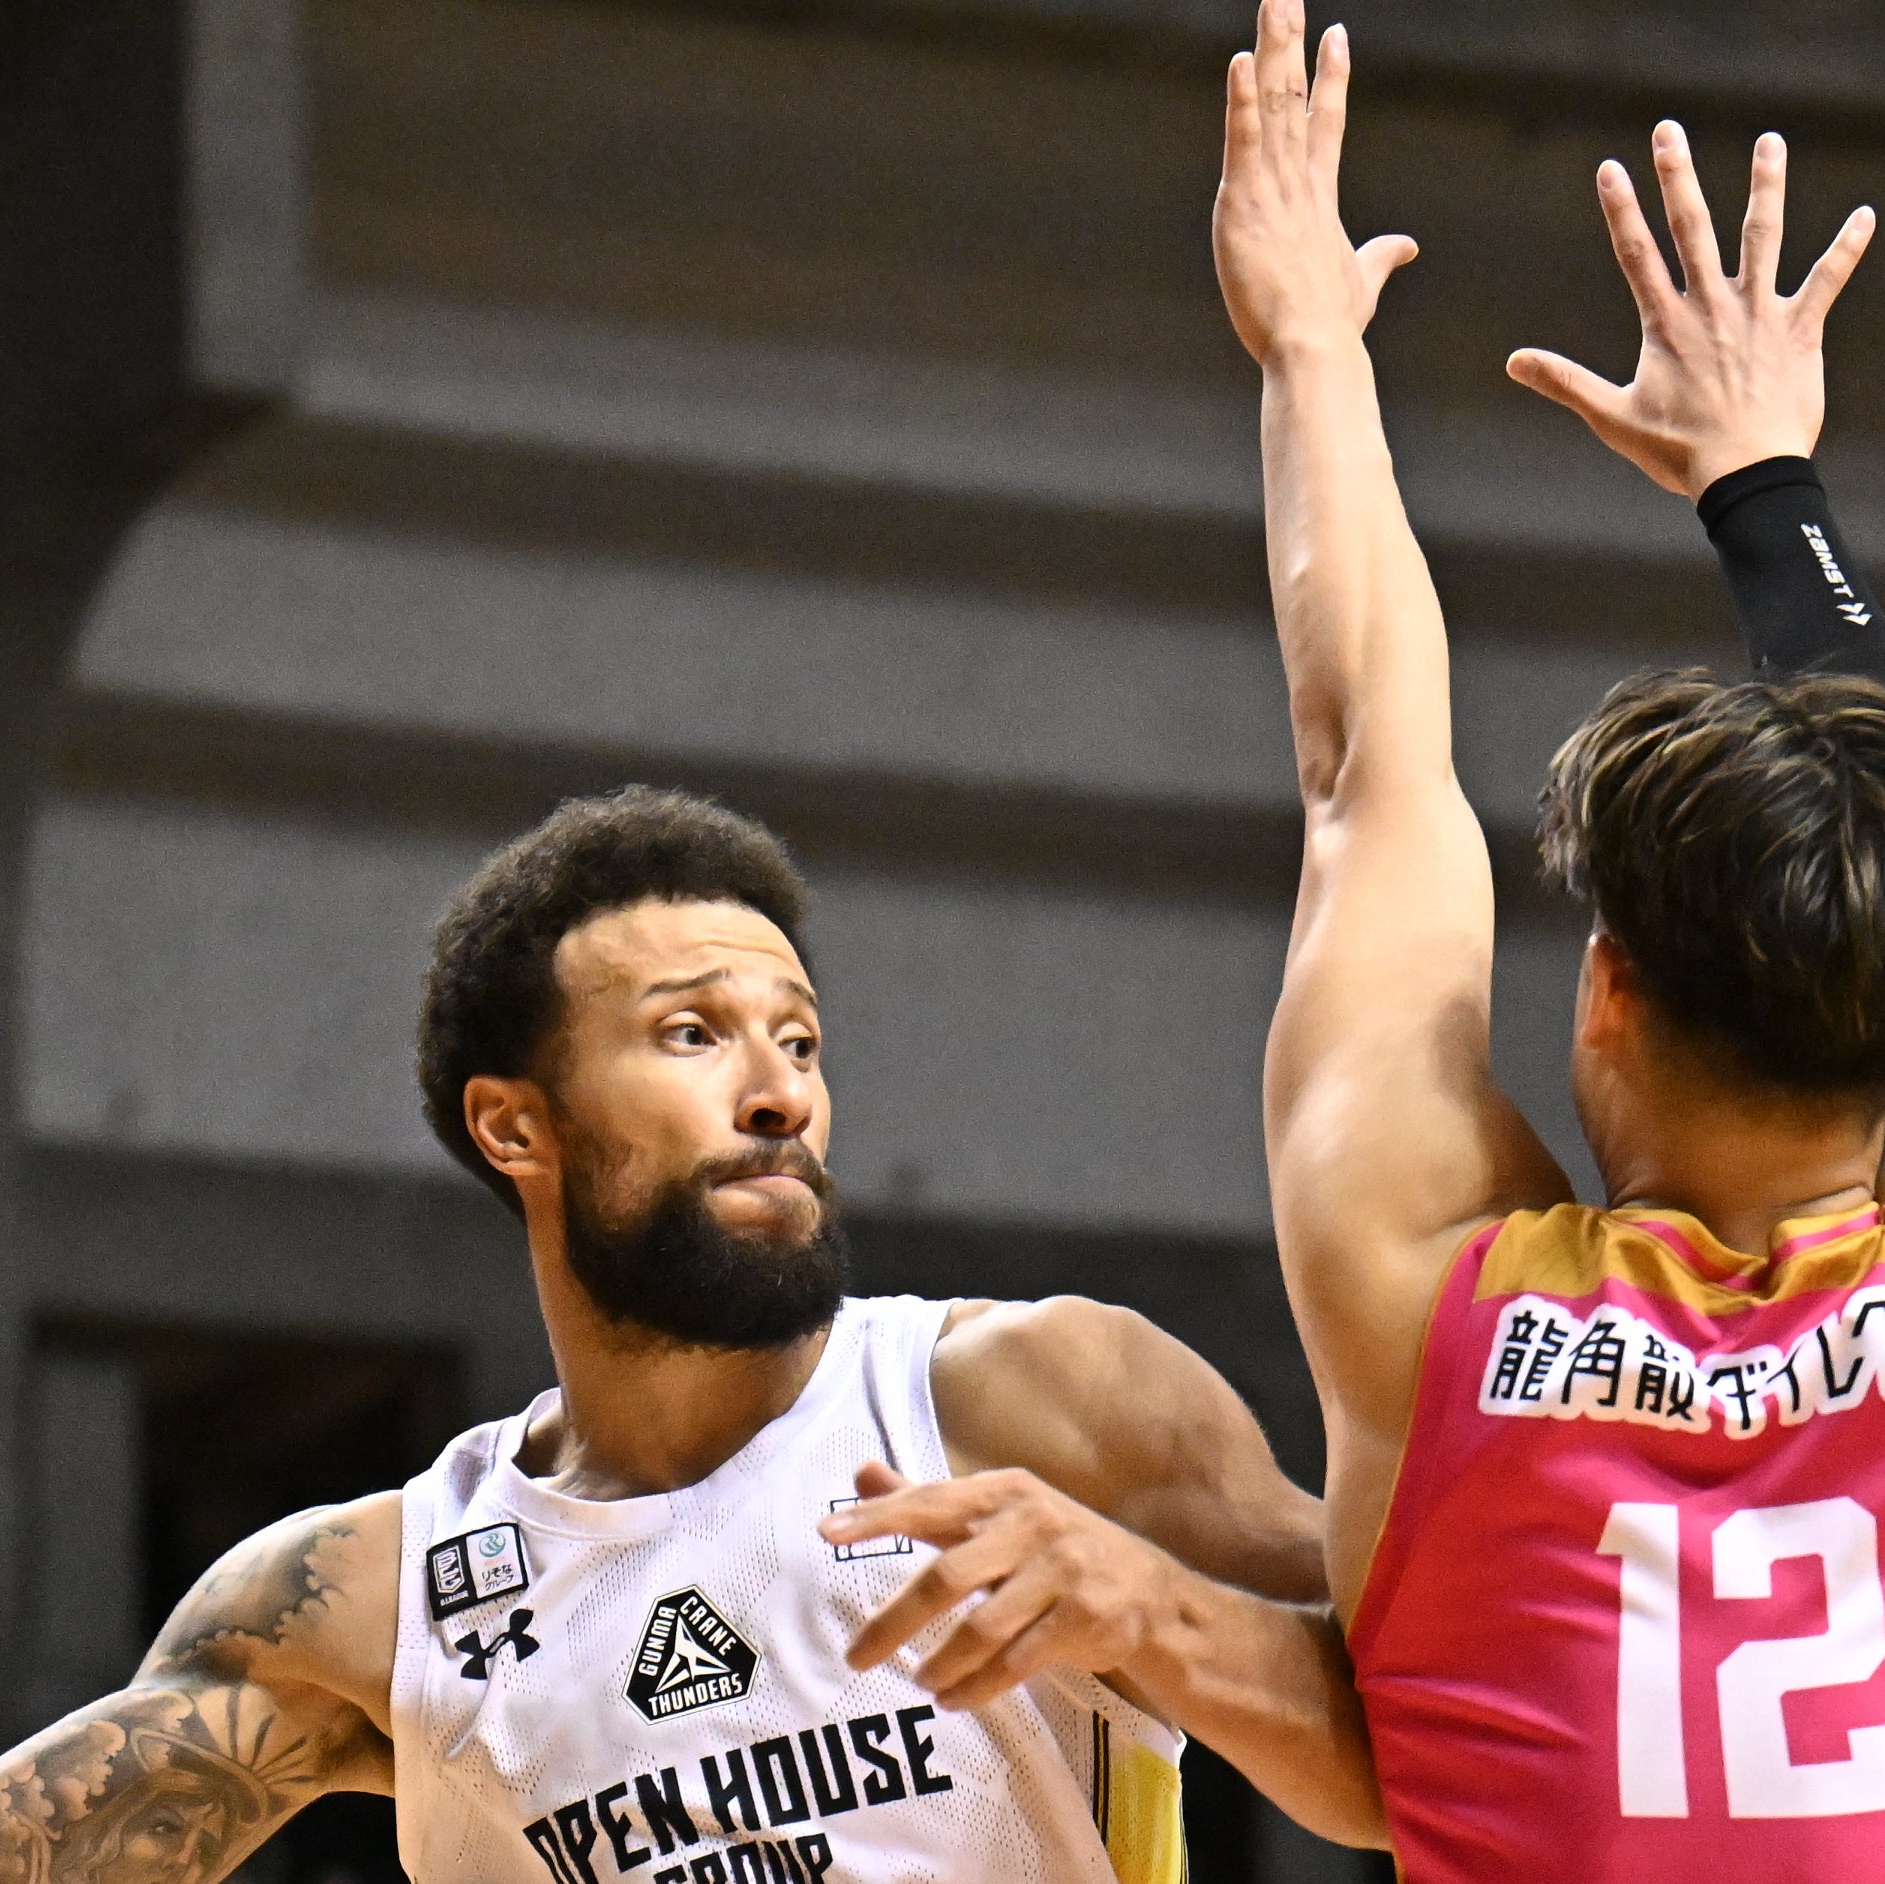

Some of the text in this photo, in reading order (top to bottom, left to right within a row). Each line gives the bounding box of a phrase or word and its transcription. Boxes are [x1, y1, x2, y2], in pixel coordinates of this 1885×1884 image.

[1800, 523, 1854, 598] ZAMST
[482, 1563, 513, 1582] りそな
[638, 1606, 677, 1677] GUNMA
[680, 1595, 737, 1656] CRANE
[648, 1672, 743, 1717] THUNDERS
[700, 1703, 954, 1833] HOUSE
